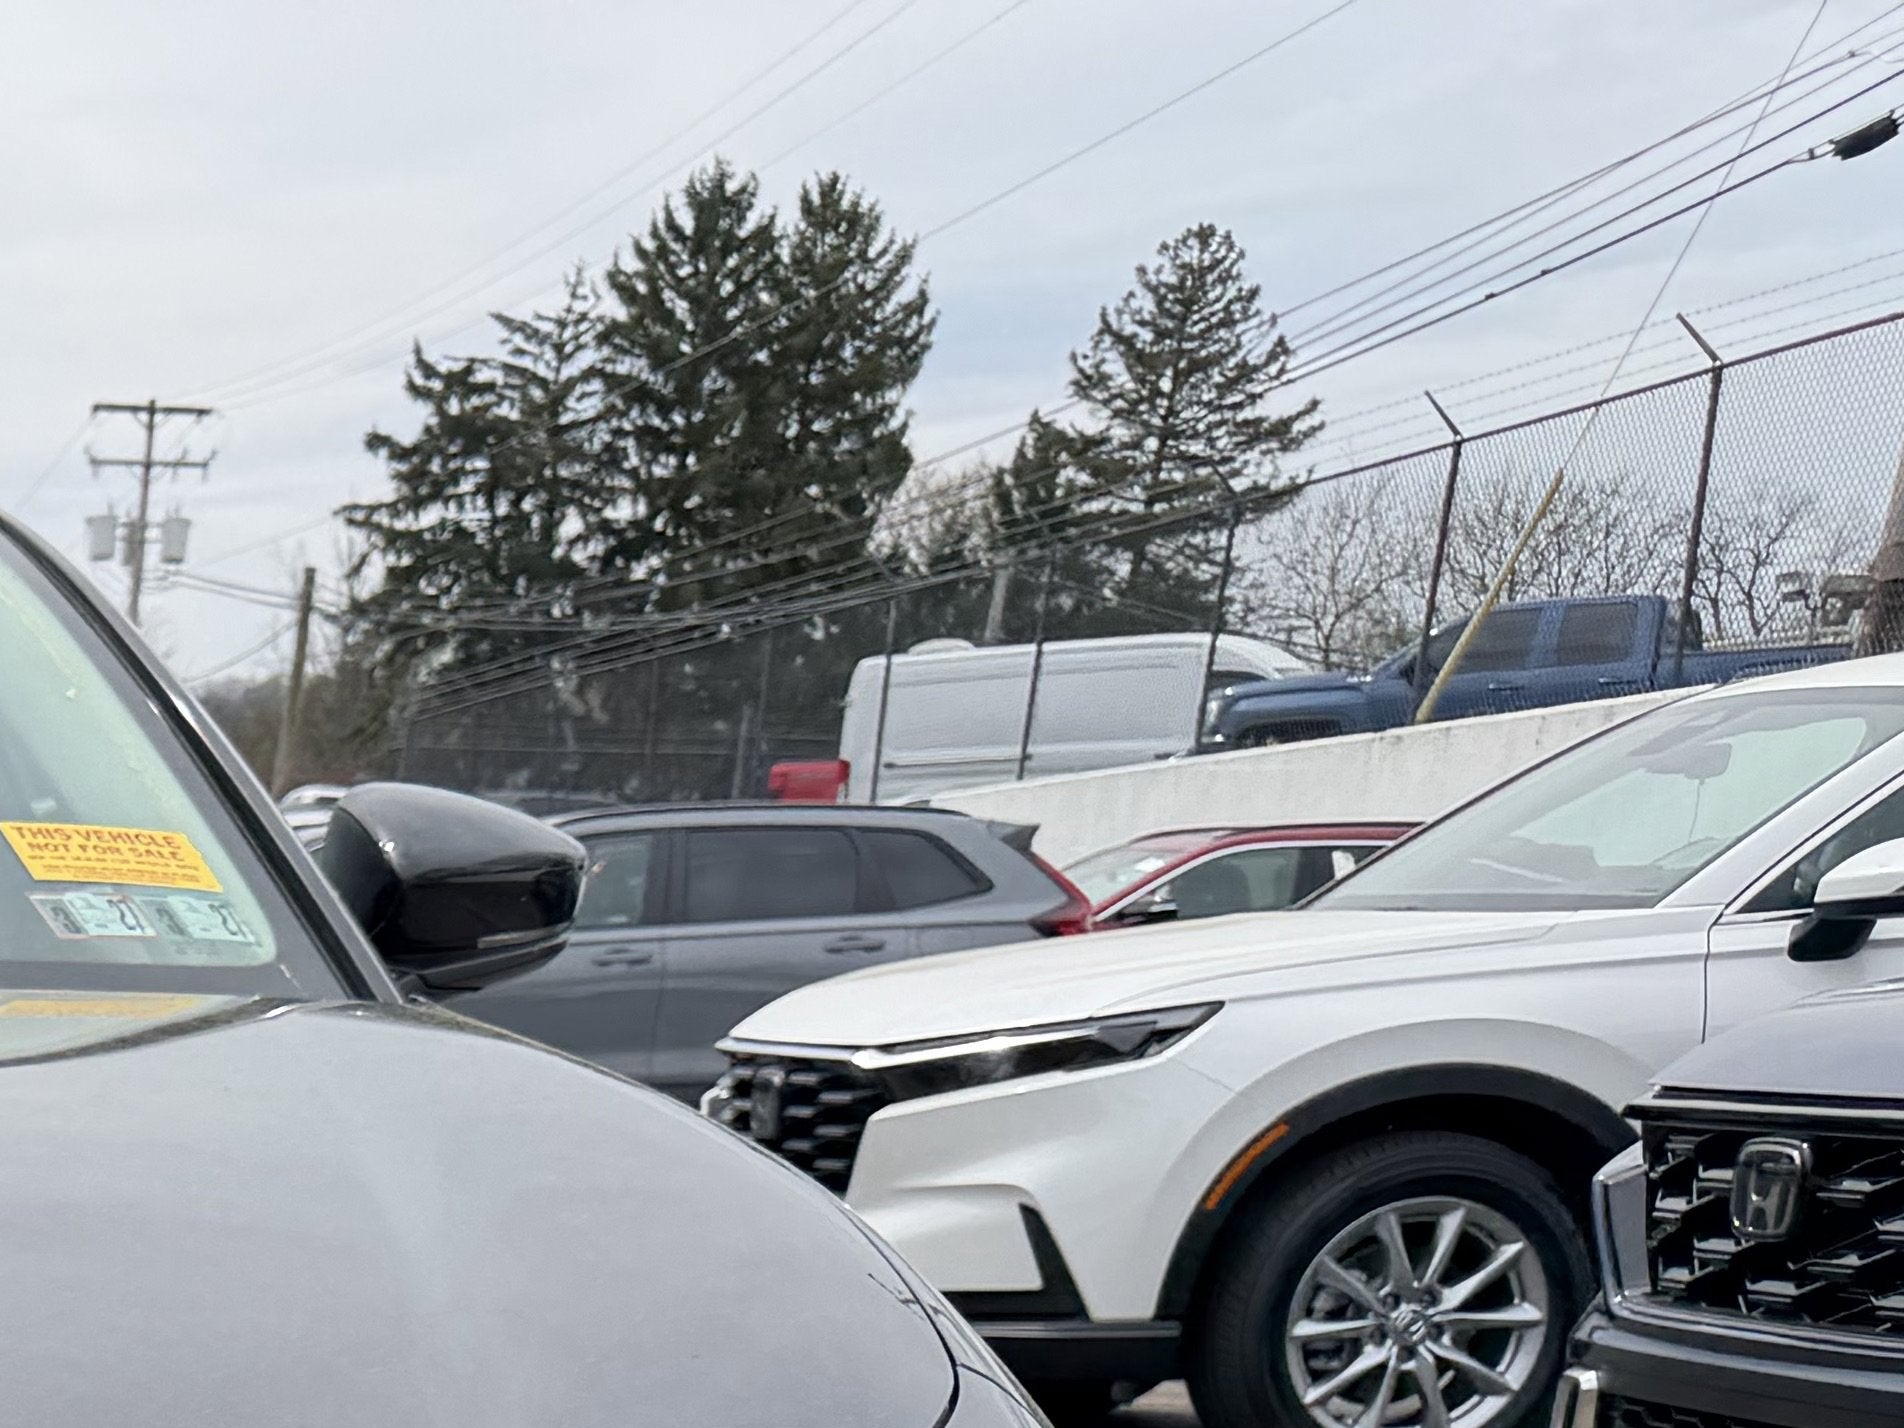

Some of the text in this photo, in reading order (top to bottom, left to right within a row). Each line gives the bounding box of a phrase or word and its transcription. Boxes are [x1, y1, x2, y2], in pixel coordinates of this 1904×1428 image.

[11, 826, 182, 850] THIS VEHICLE
[27, 842, 185, 862] NOT FOR SALE
